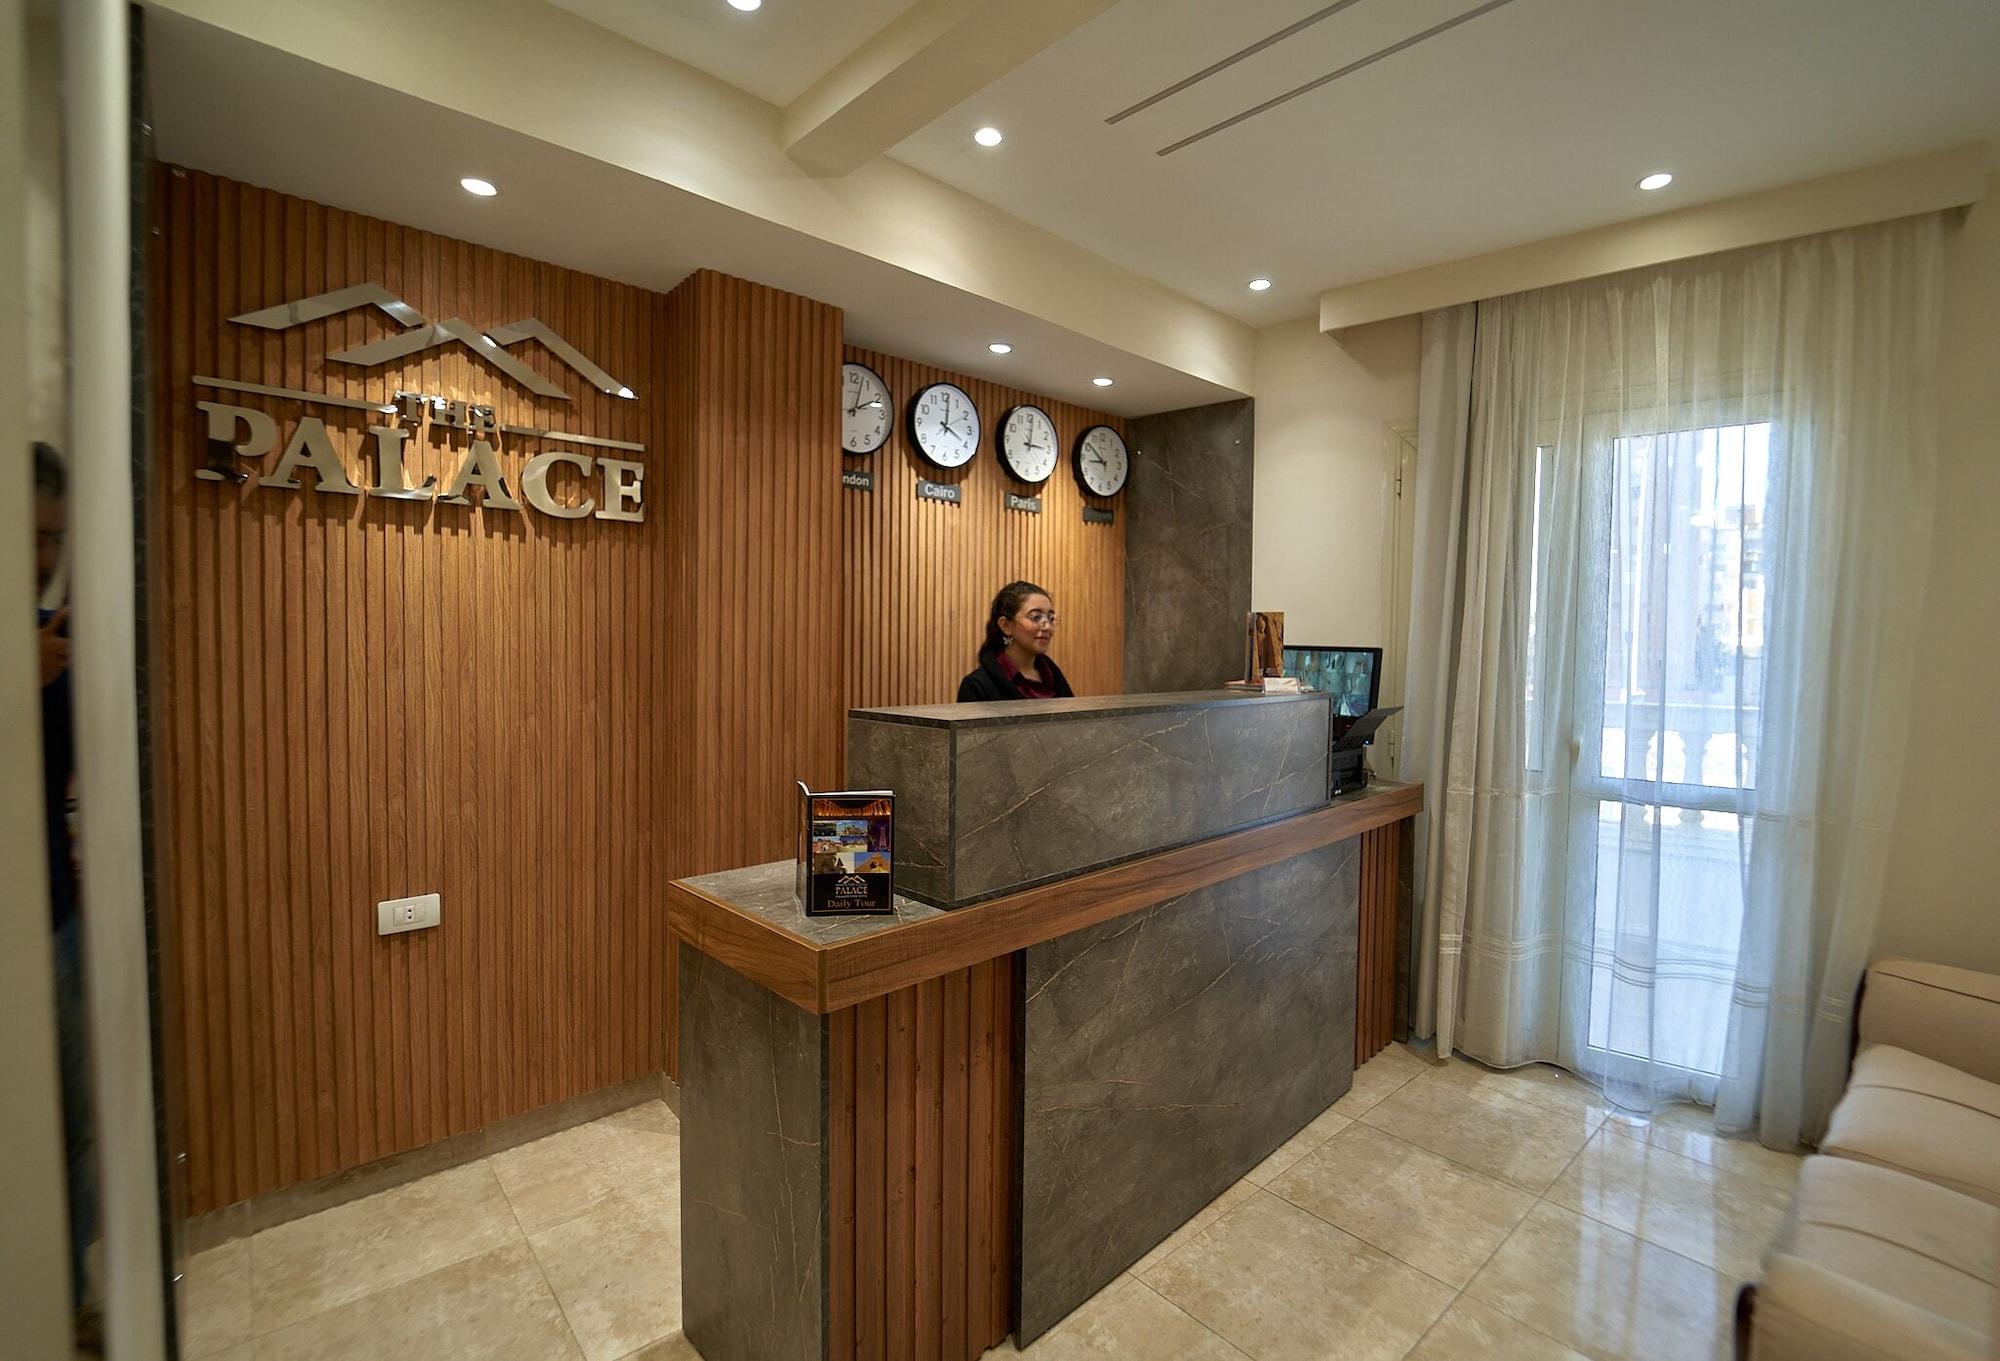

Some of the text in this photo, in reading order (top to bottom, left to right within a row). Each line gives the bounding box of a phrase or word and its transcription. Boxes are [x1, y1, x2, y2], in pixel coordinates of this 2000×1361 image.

[849, 372, 859, 384] 12
[930, 395, 938, 405] 11
[941, 392, 950, 403] 12
[394, 390, 497, 432] THE
[879, 409, 885, 420] 3
[921, 404, 930, 415] 10
[963, 410, 969, 420] 2
[917, 417, 922, 427] 9
[874, 425, 880, 434] 4
[967, 426, 972, 436] 3
[1009, 423, 1016, 433] 10
[864, 434, 871, 445] 5
[922, 433, 927, 444] 8
[1044, 431, 1050, 440] 2
[850, 436, 857, 447] 6
[930, 445, 936, 454] 7
[954, 449, 960, 459] 5
[1046, 445, 1052, 454] 3
[196, 400, 645, 523] PALACE
[942, 452, 948, 461] 6
[1016, 460, 1020, 469] 7
[842, 474, 870, 486] ndon
[924, 484, 956, 498] Cairo
[1010, 496, 1036, 510] Paris
[835, 886, 868, 894] PALACE
[827, 899, 875, 908] Daily Tour
